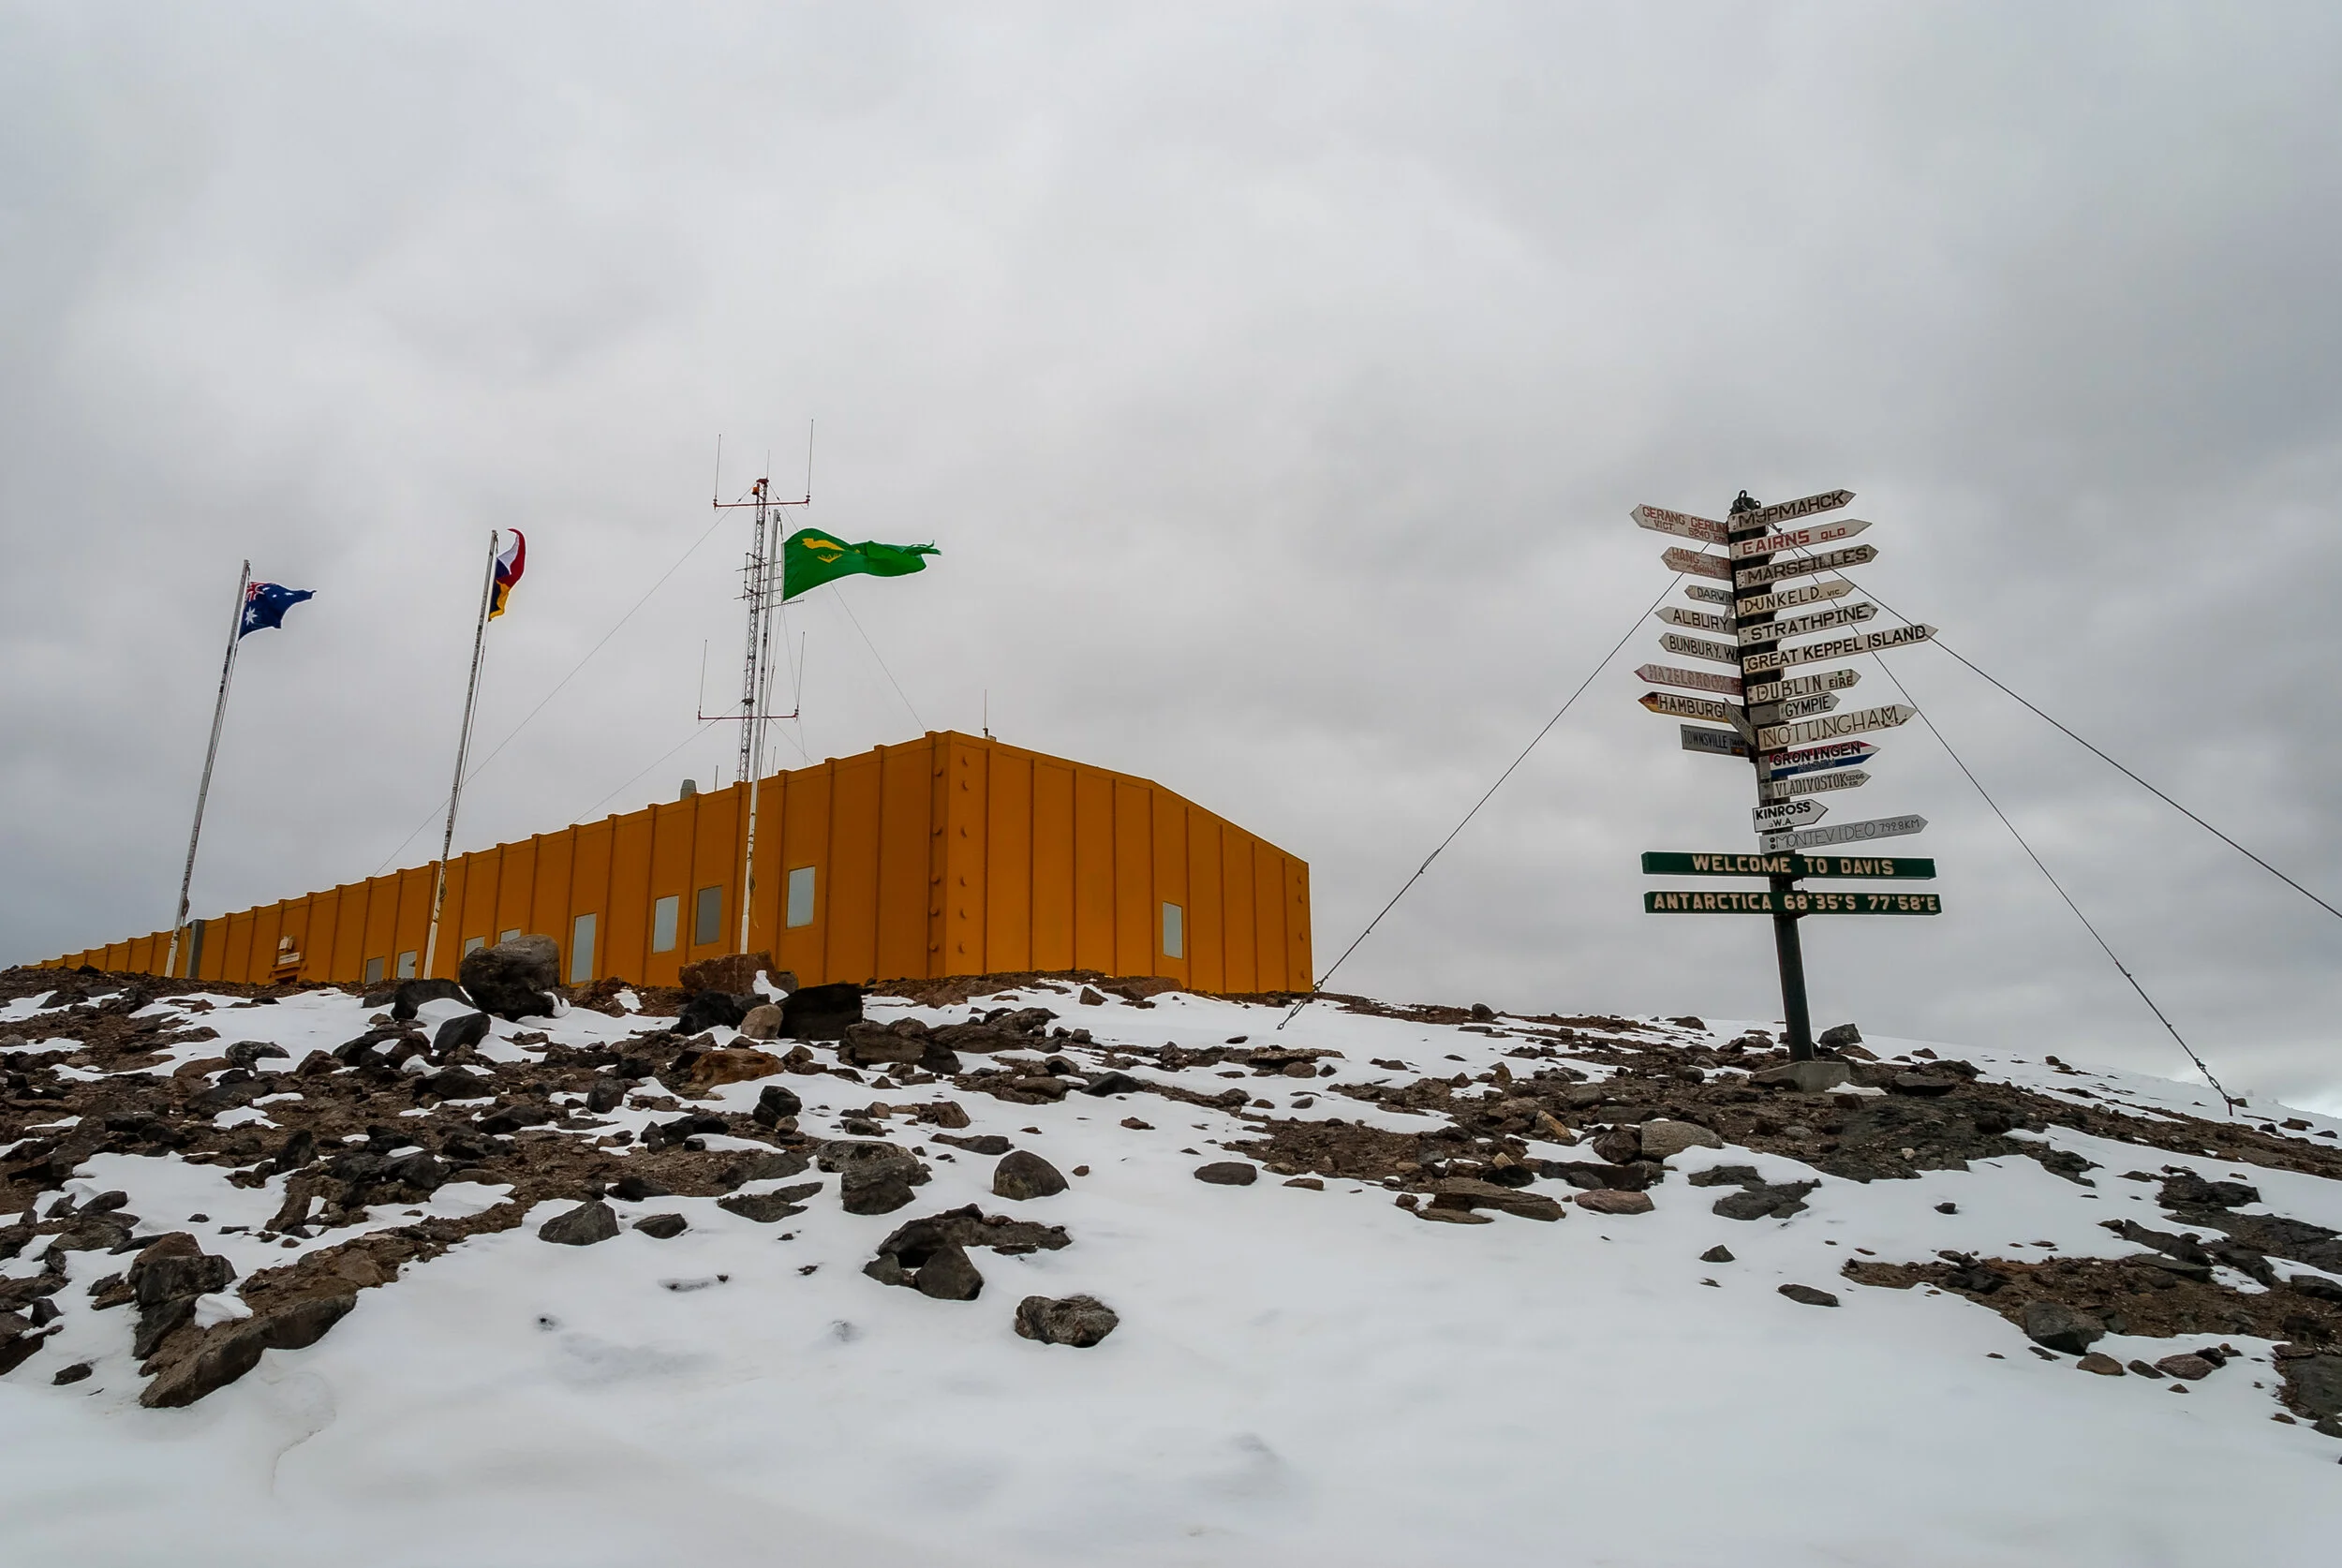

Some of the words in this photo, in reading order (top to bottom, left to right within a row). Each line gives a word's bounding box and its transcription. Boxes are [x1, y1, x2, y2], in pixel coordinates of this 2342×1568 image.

[1642, 506, 1685, 525] GERANG
[1688, 527, 1711, 540] 5240
[1742, 530, 1810, 555] CAIRNS
[1820, 527, 1846, 541] QLD
[1747, 548, 1869, 584] MARSEILLES
[1697, 587, 1734, 602] DARWIN
[1673, 609, 1728, 631] ALBURY
[1751, 604, 1871, 641] STRATHPINE
[1747, 648, 1798, 671] GREAT
[1803, 637, 1863, 660] KEPPEL
[1867, 625, 1926, 648] ISLAND
[1756, 674, 1822, 702] DUBLIN
[1659, 695, 1723, 718] HAMBURG
[1785, 695, 1831, 717] GYMPIE
[1762, 705, 1899, 747] NOTTINGHAM
[1683, 730, 1727, 749] TOWNSVILLE
[1773, 743, 1861, 766] GRONINGEN
[1775, 774, 1846, 796] VLADIVOSTOK
[1756, 802, 1811, 821] KINROSS
[1772, 818, 1795, 827] W.A.
[1776, 821, 1875, 849] MONTEVIDEO
[1692, 854, 1792, 873] WELCOME
[1804, 857, 1829, 874] TO
[1840, 858, 1894, 876] DAVIS
[1653, 893, 1772, 910] ANTARCTICA
